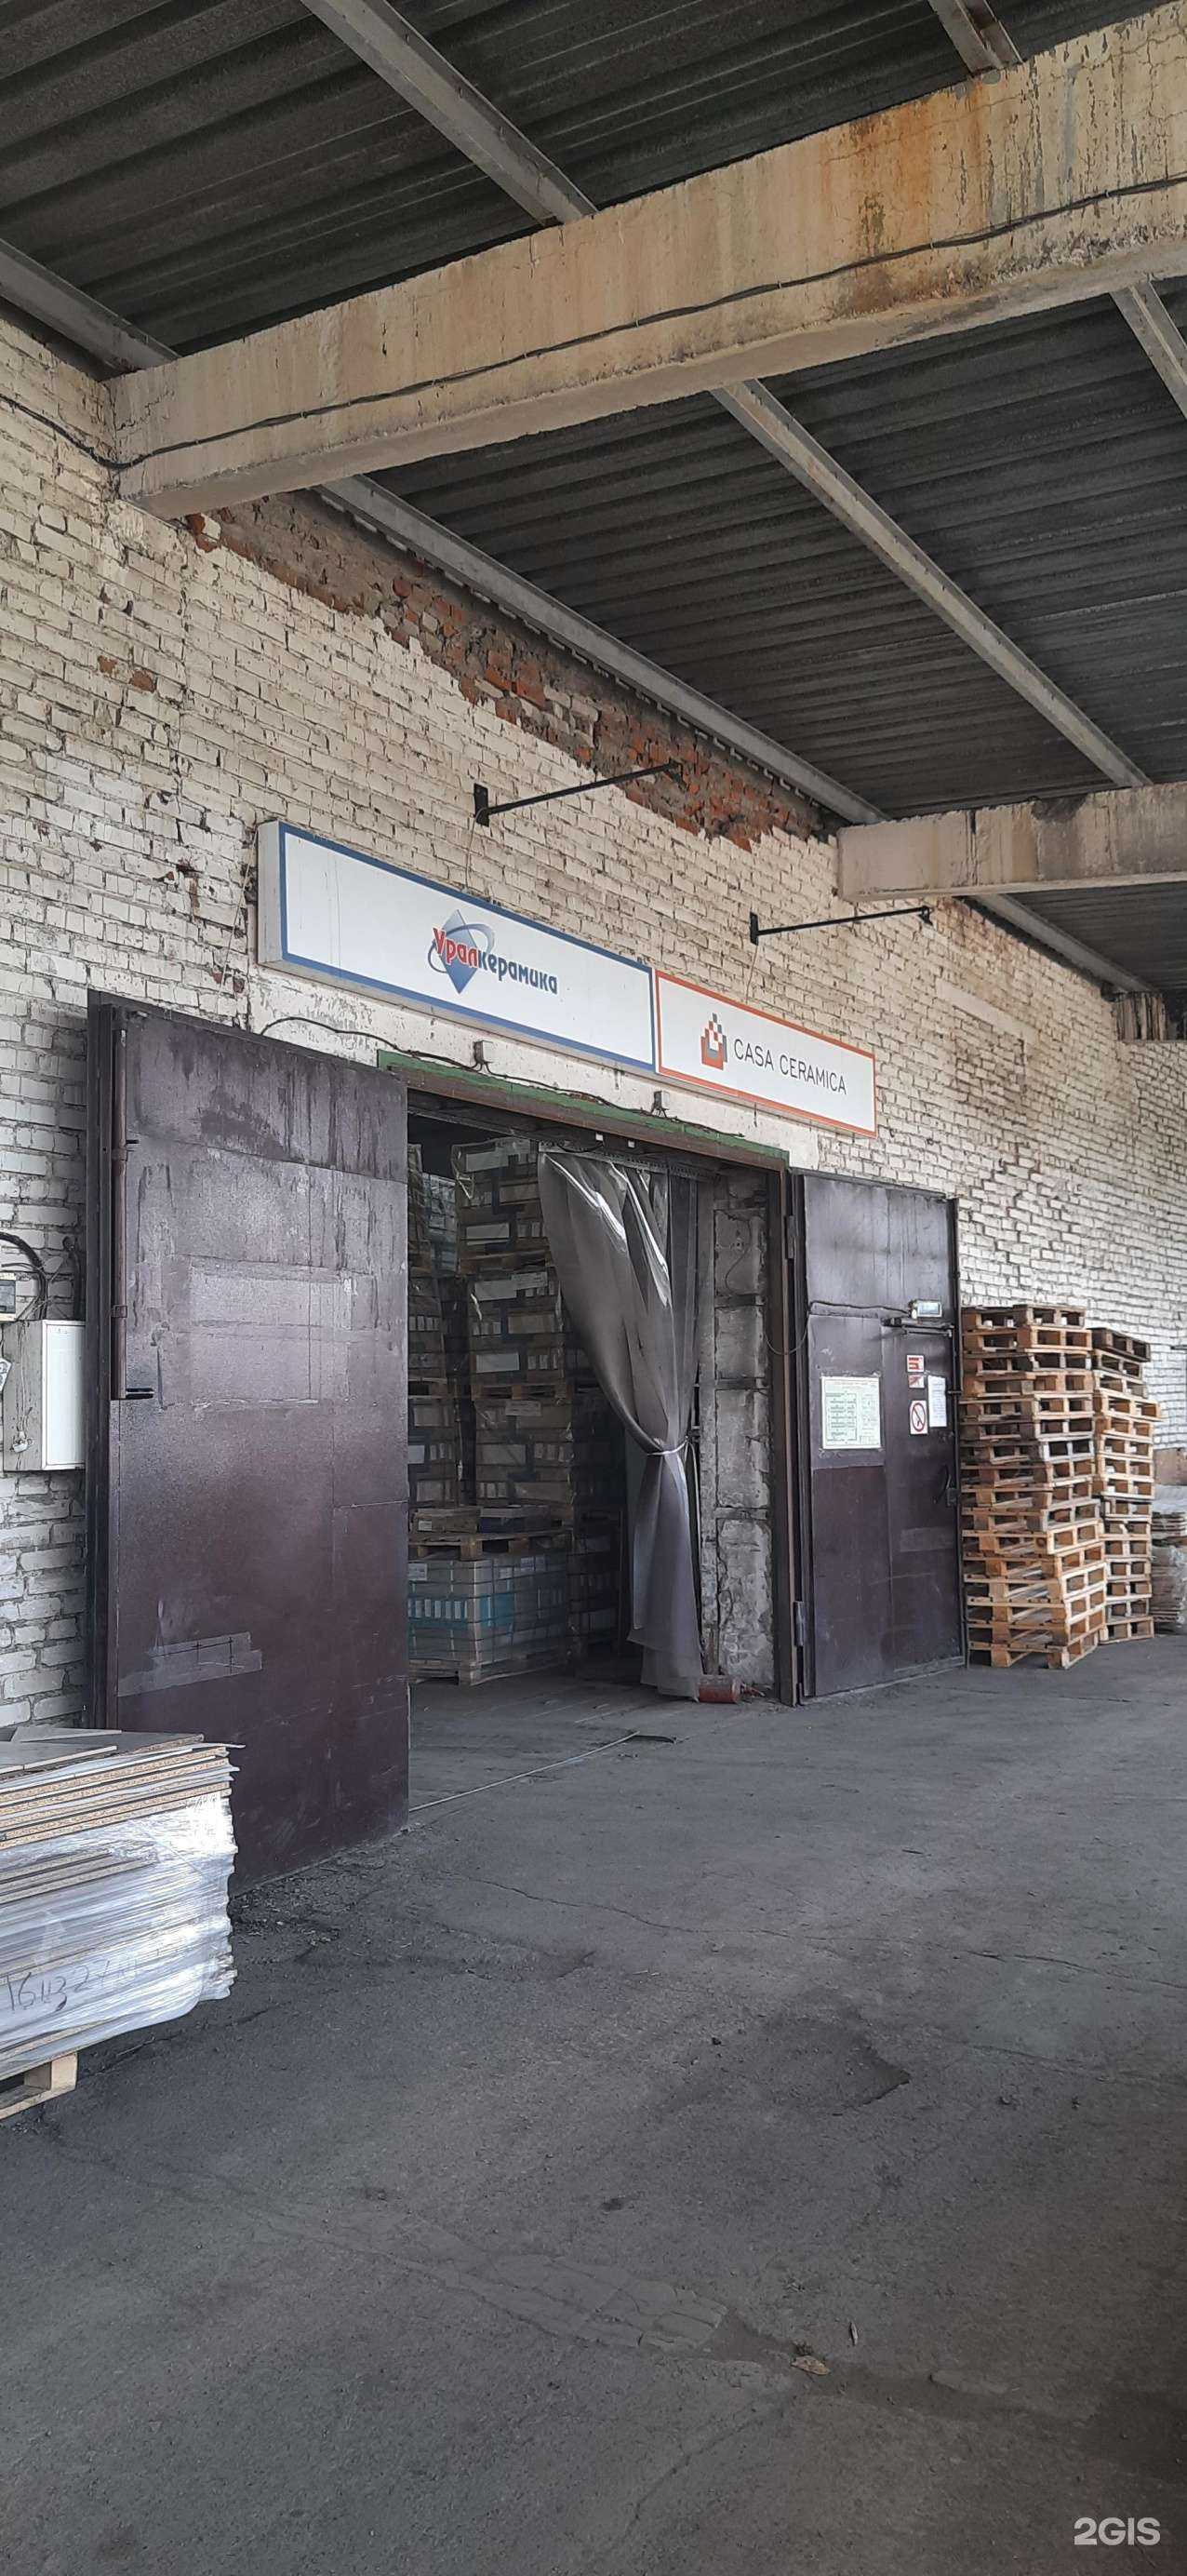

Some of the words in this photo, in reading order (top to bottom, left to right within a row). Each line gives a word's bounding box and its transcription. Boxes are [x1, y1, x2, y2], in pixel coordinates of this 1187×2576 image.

[433, 928, 557, 995] Уралкерамика
[733, 1039, 774, 1071] CASA
[780, 1054, 847, 1095] CERAMICA
